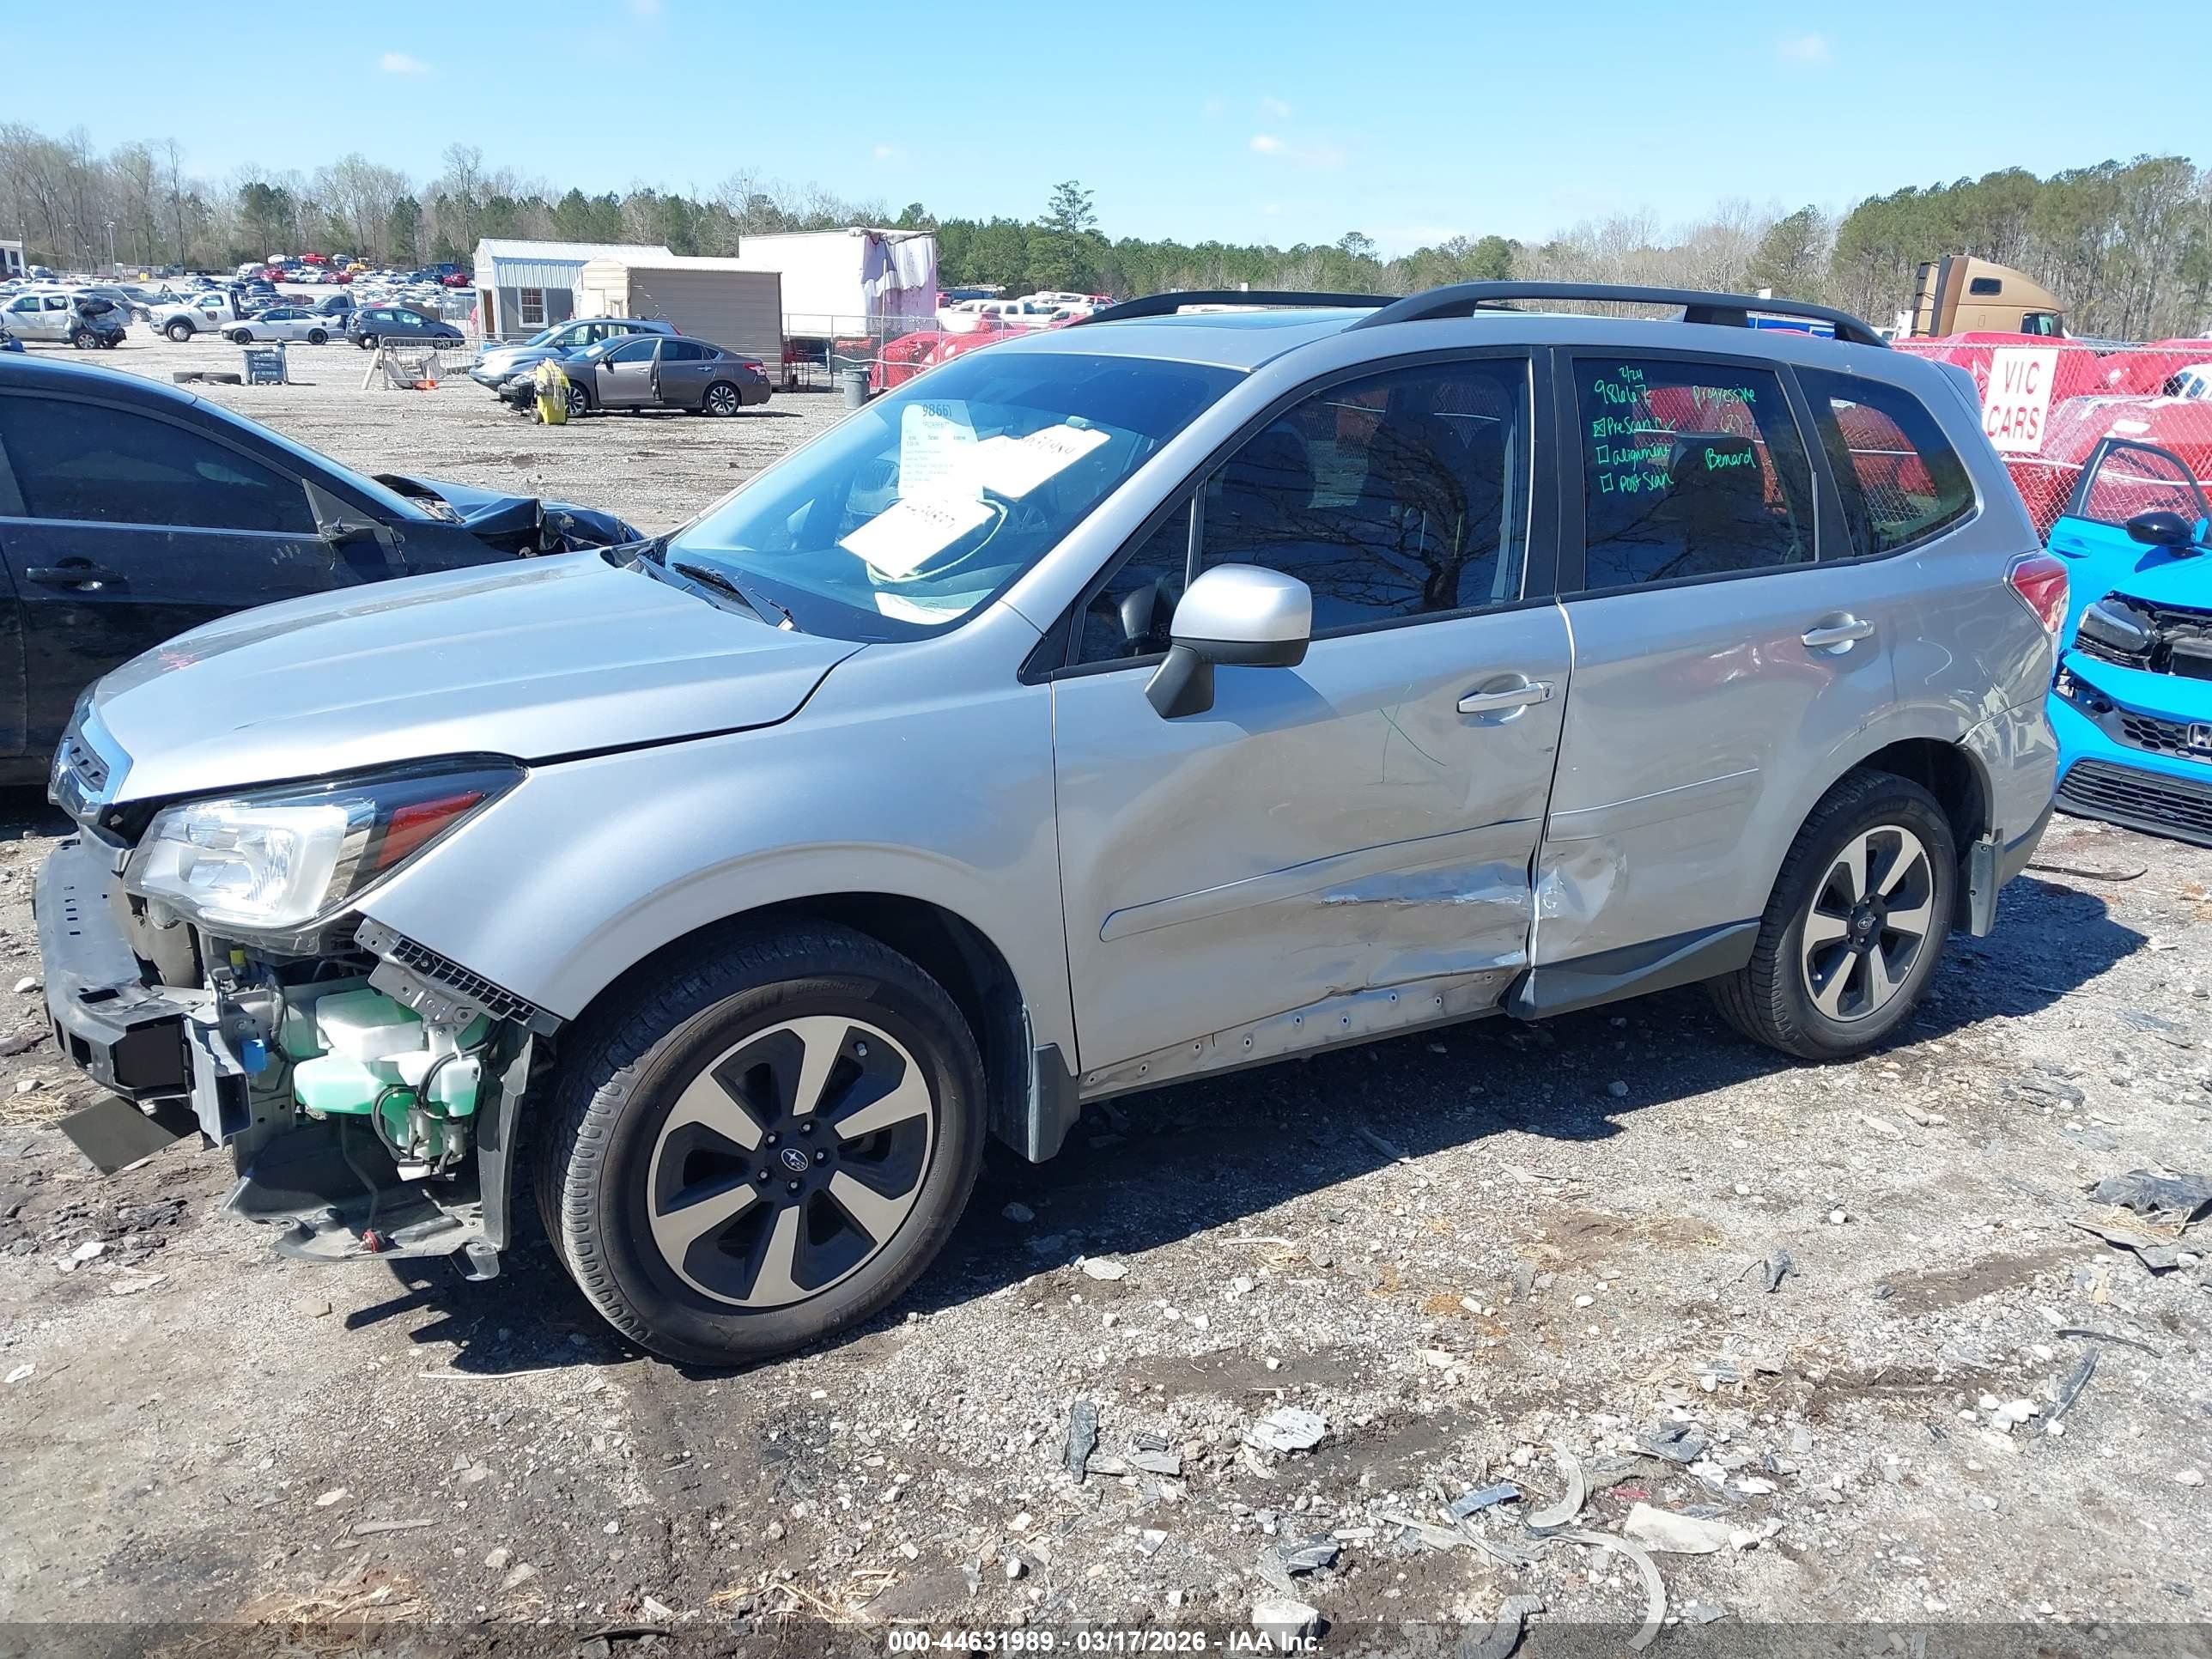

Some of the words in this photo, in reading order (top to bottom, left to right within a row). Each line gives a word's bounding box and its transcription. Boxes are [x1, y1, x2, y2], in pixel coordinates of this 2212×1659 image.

[1619, 365, 1644, 383] 2/24
[2004, 360, 2040, 395] VIC
[1595, 380, 1648, 404] 98667
[1986, 405, 2040, 441] CARS
